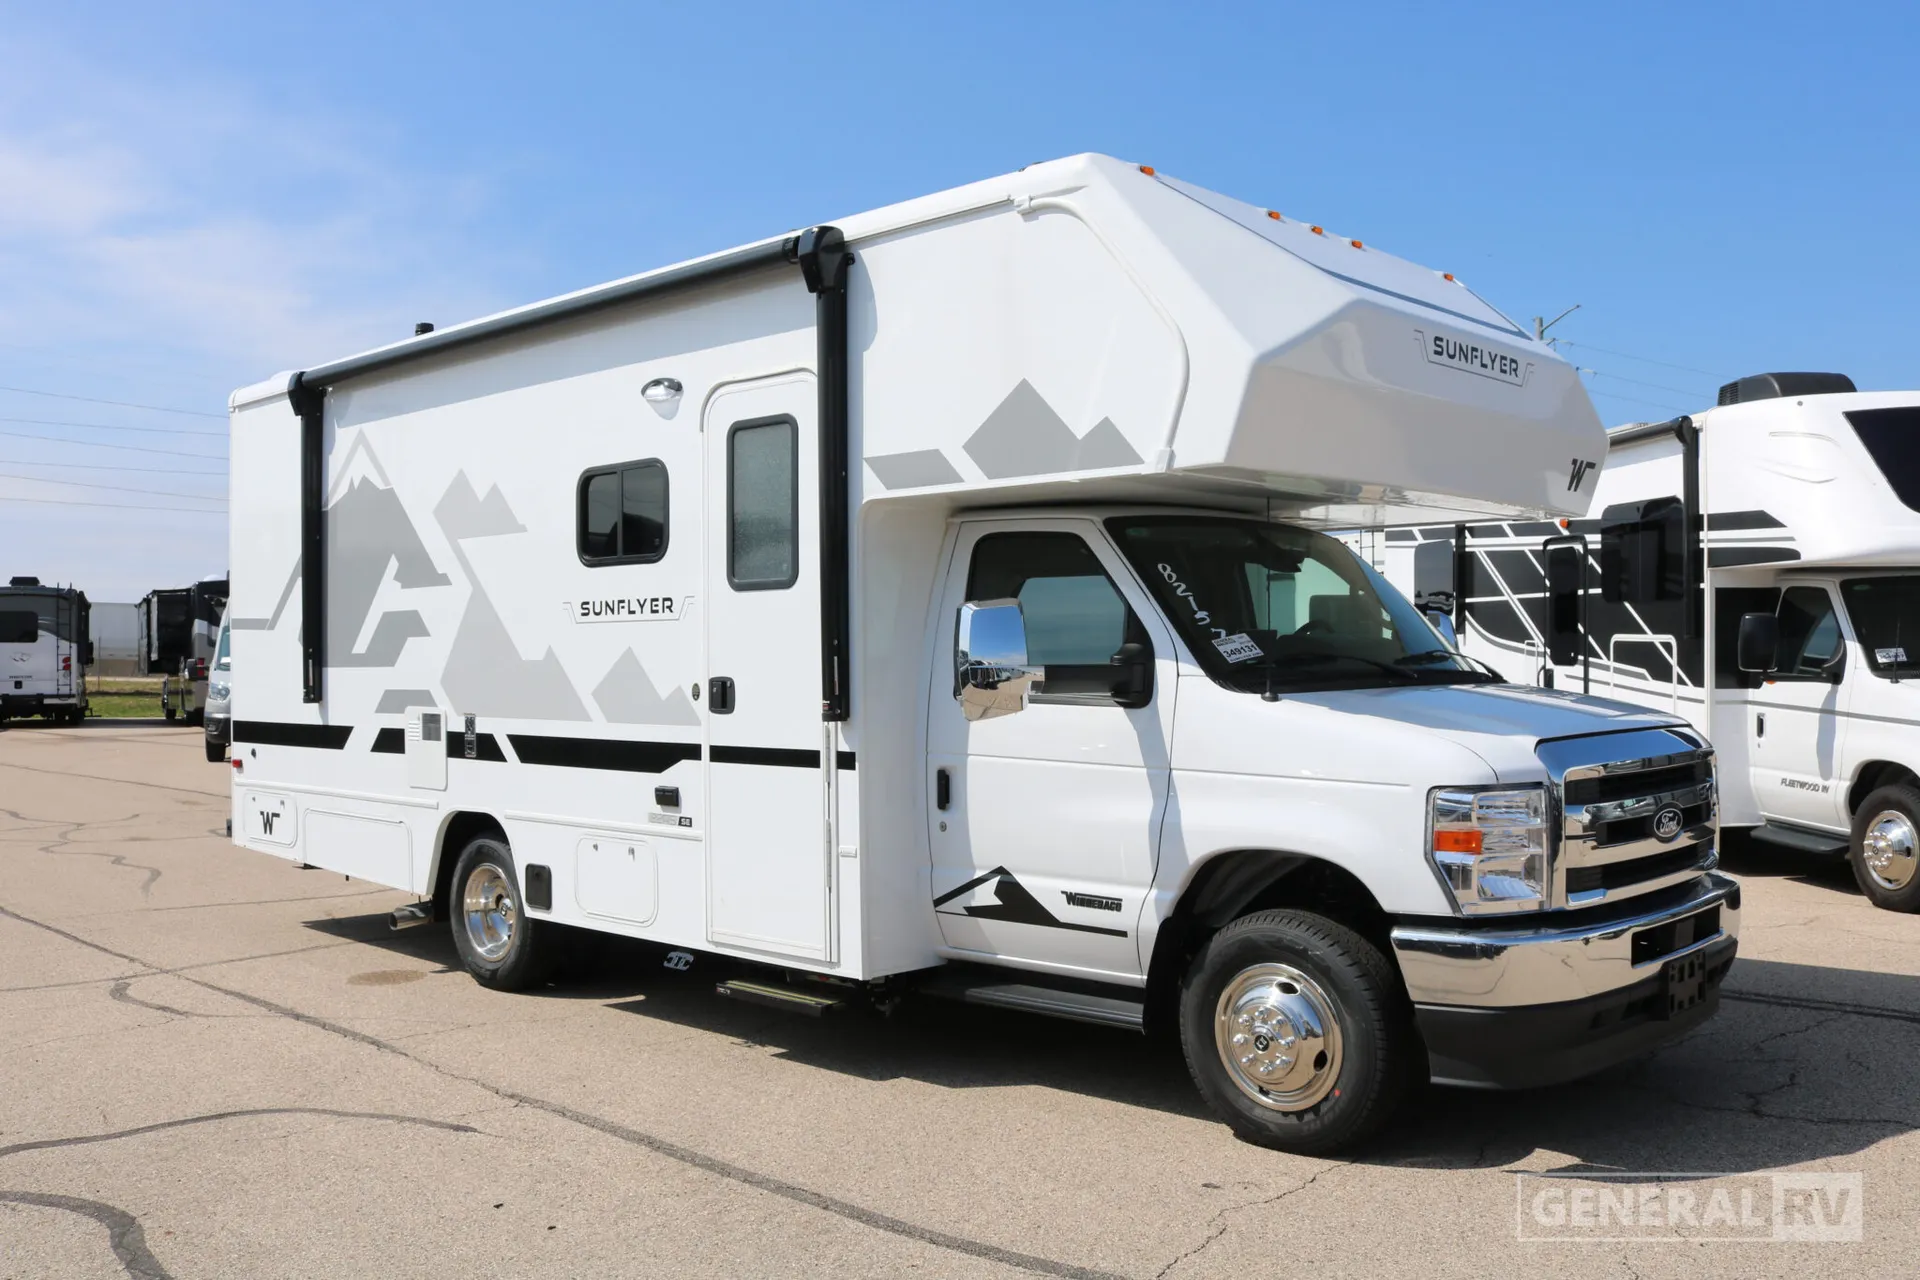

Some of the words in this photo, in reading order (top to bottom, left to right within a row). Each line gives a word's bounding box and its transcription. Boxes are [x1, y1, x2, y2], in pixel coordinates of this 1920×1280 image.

[1433, 336, 1519, 377] SUNFLYER
[580, 597, 674, 616] SUNFLYER
[1223, 644, 1258, 658] 349131
[1660, 812, 1678, 833] Ford
[1060, 890, 1123, 912] WINNEBAGO
